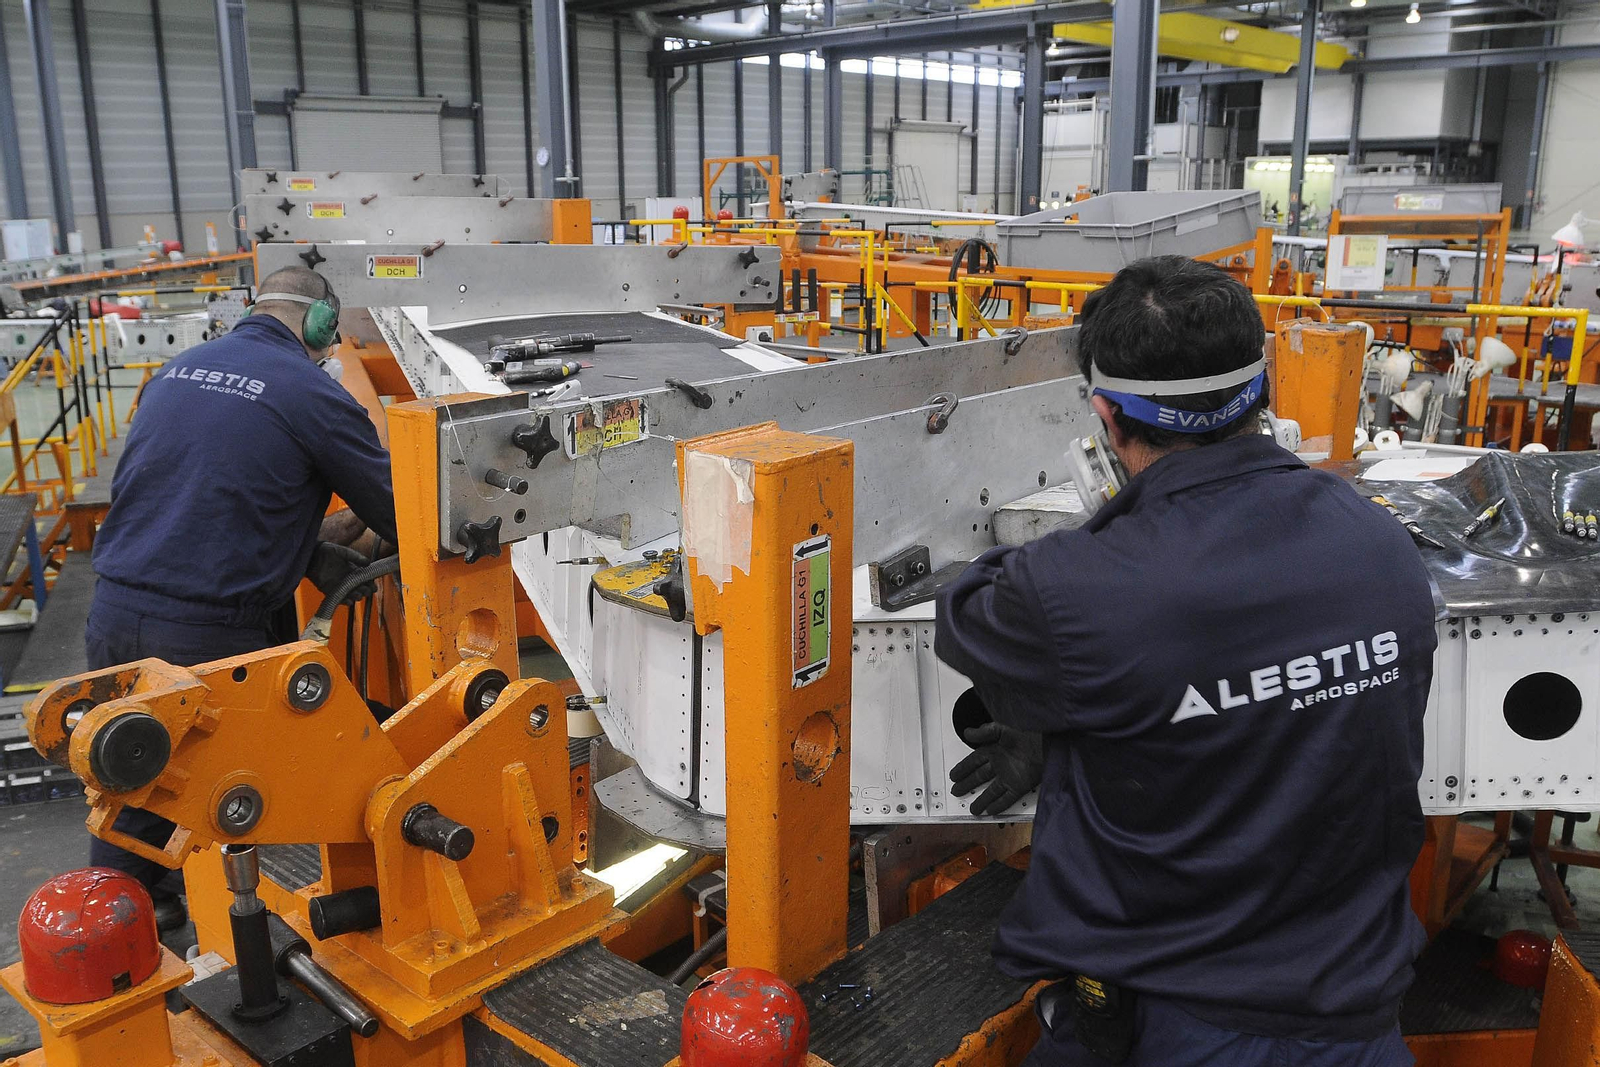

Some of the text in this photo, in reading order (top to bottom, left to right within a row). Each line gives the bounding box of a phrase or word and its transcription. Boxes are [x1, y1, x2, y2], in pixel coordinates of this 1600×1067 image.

[369, 257, 374, 277] 2
[386, 268, 406, 276] DCH
[161, 366, 266, 395] ALESTIS
[199, 383, 258, 401] AEROSPACE
[595, 425, 622, 443] DCH
[798, 570, 807, 660] CUCHILLA G1
[813, 588, 826, 628] IZQ
[1169, 630, 1399, 725] ALESTIS
[1290, 666, 1400, 711] AEROSPACE
